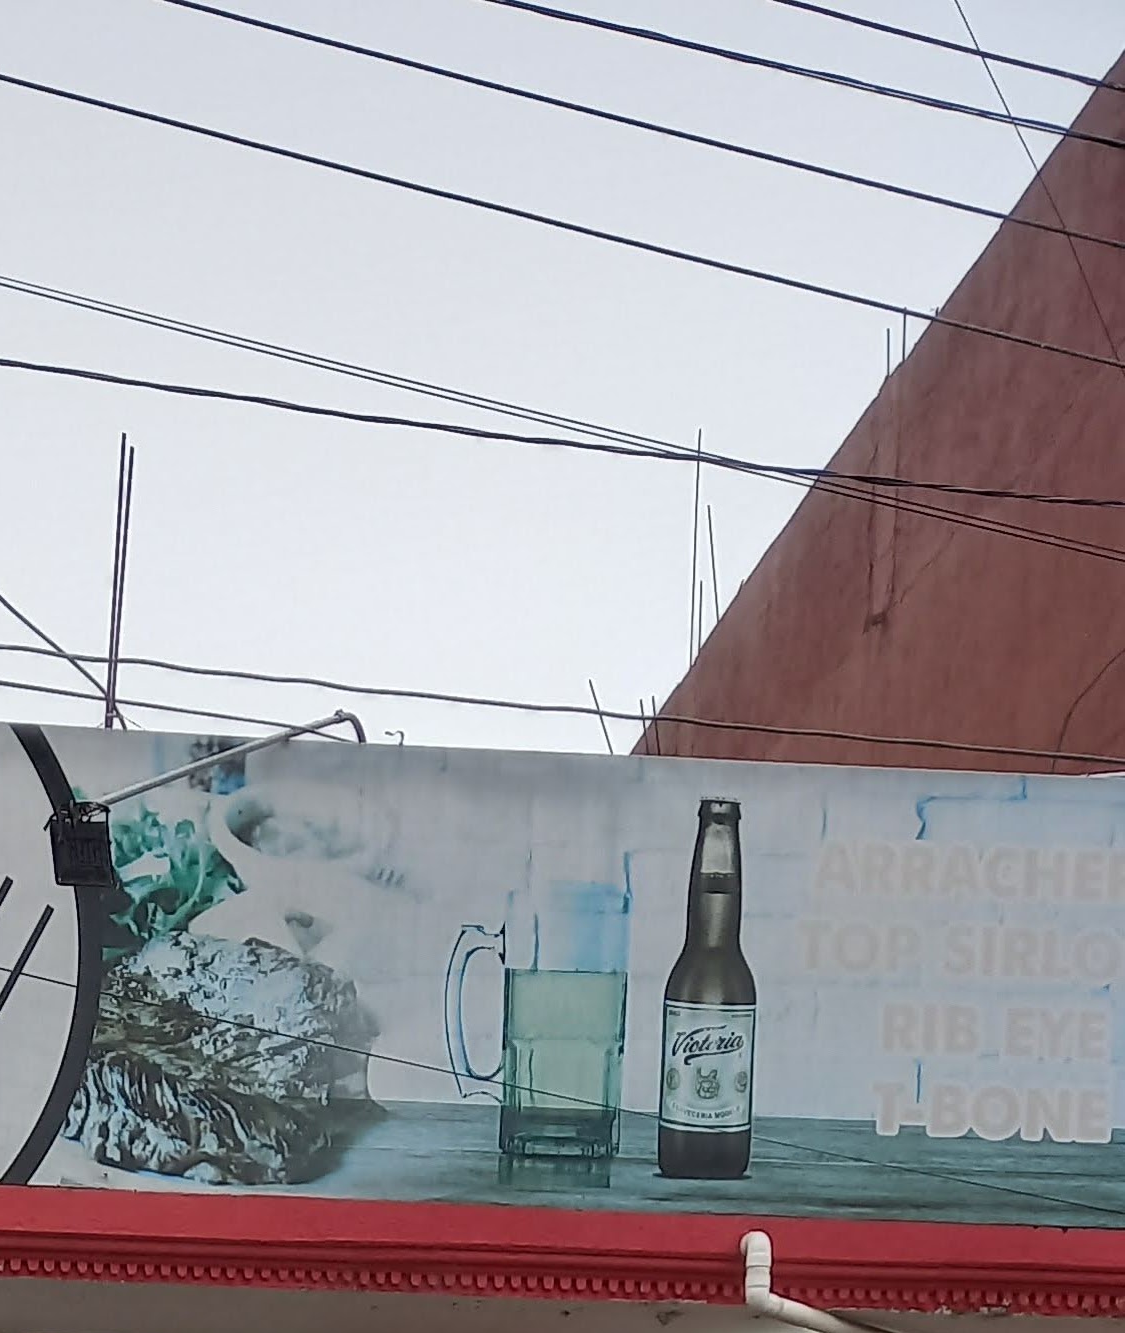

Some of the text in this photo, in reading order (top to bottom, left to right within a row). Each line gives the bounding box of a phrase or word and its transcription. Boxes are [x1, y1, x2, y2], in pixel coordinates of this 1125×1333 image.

[797, 919, 920, 972] TOP
[883, 1003, 1106, 1057] RIB EYE
[873, 1082, 1109, 1140] T-BONE
